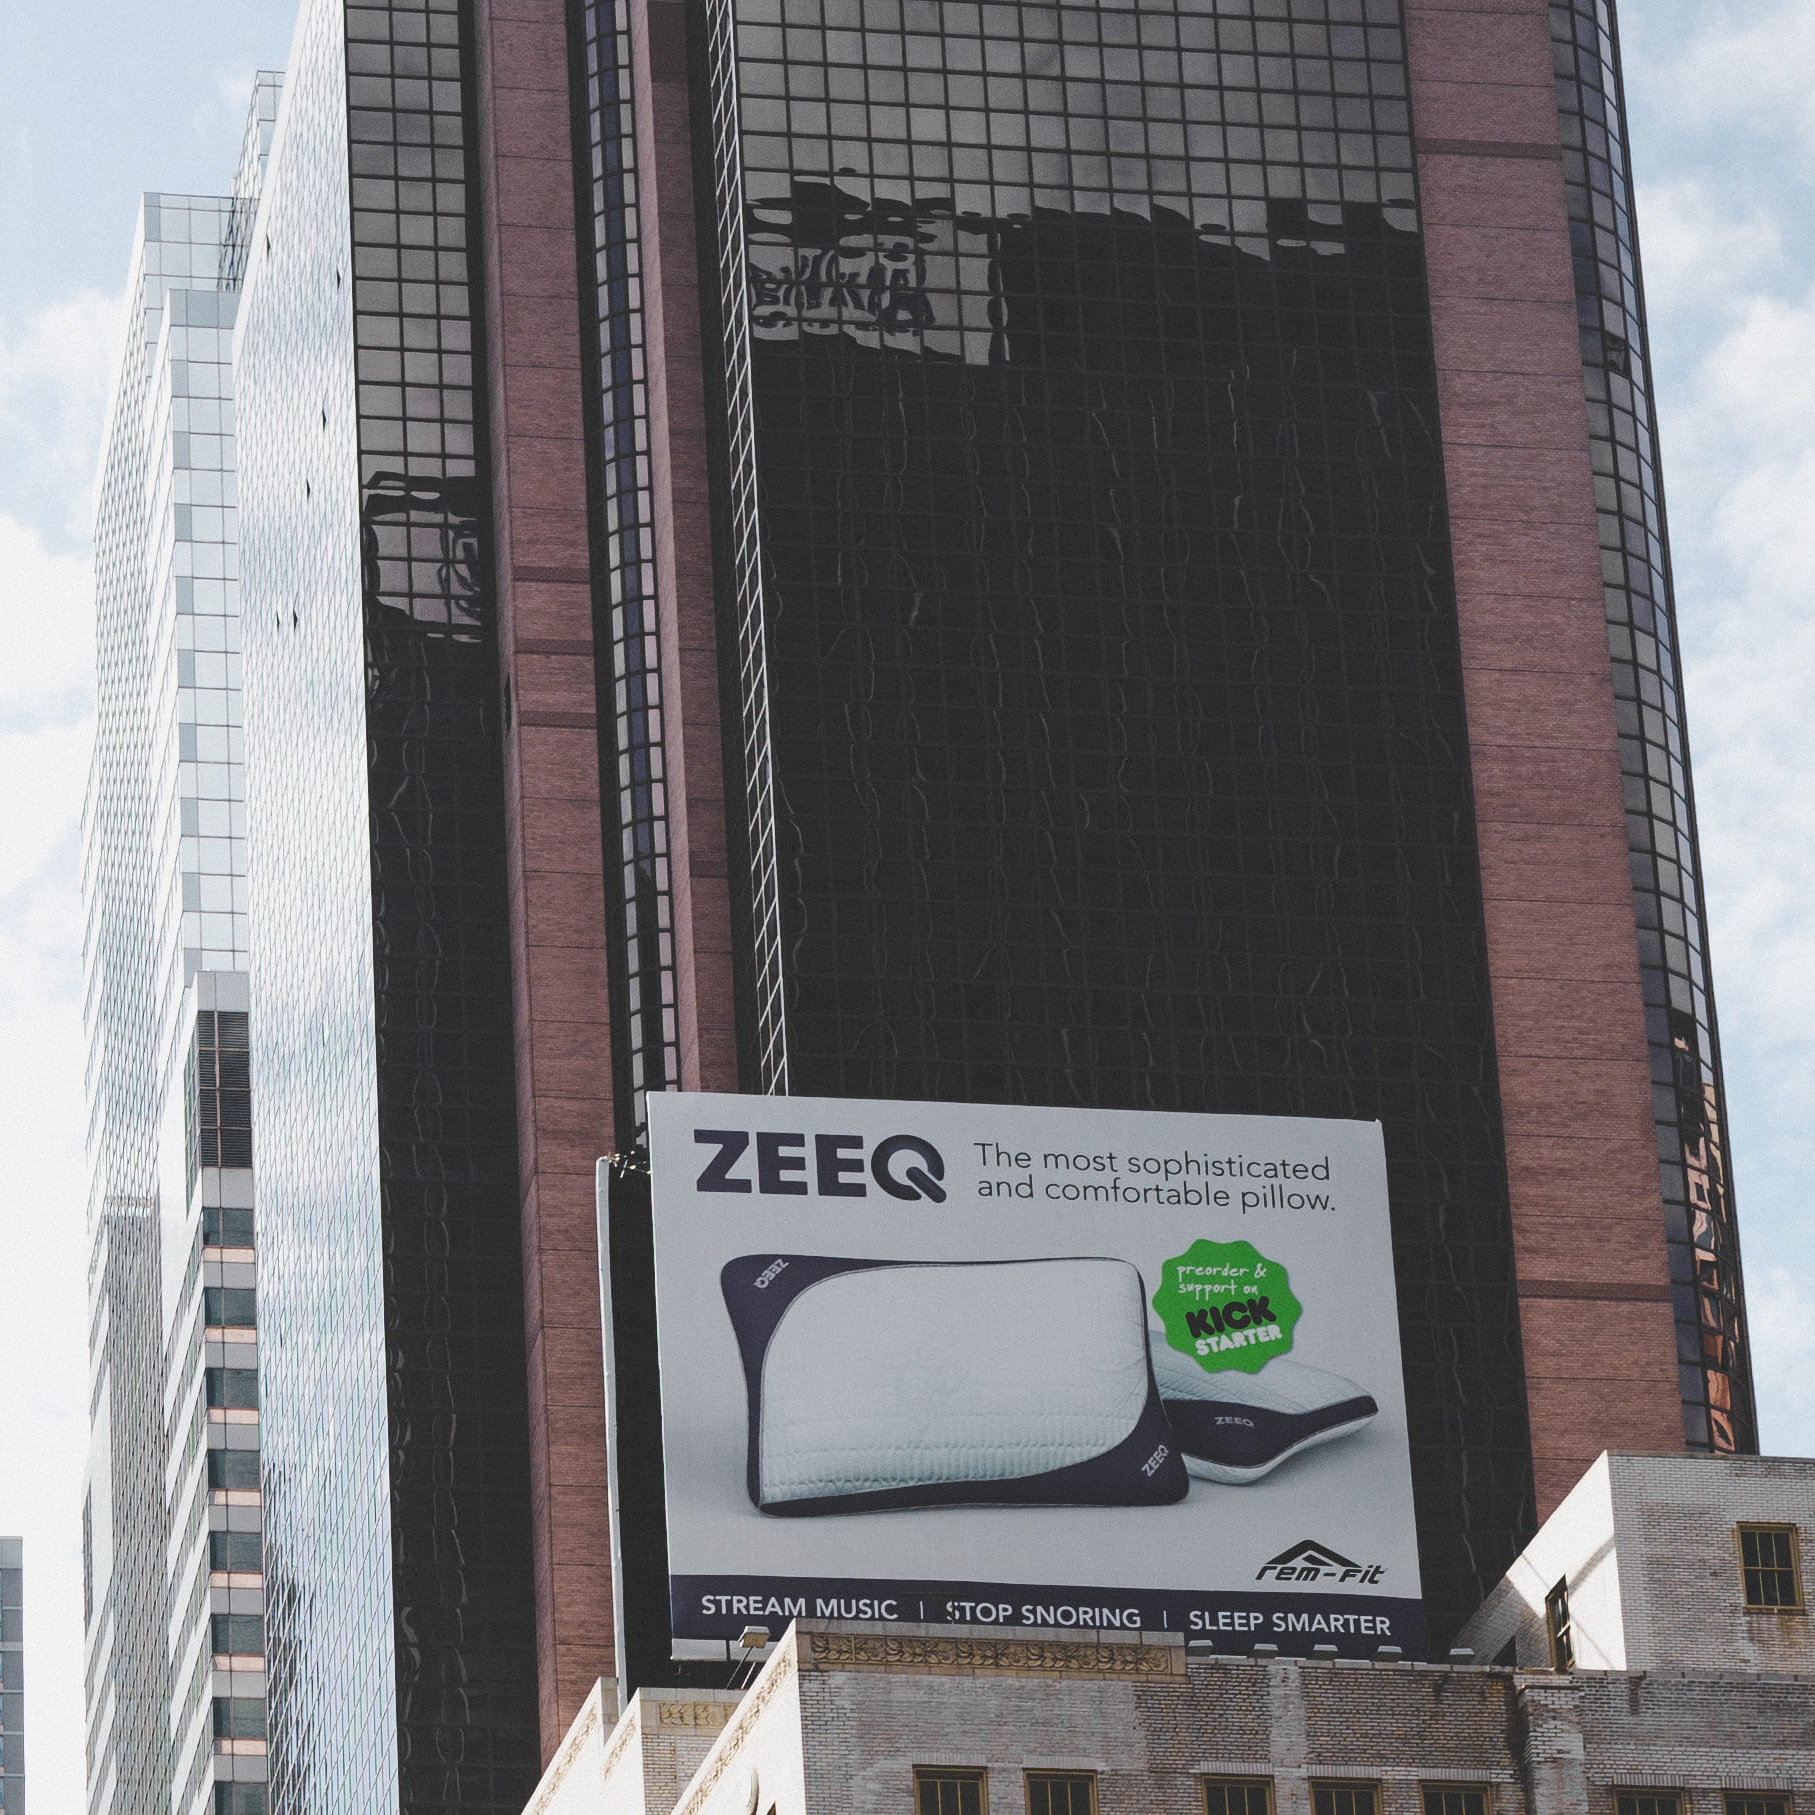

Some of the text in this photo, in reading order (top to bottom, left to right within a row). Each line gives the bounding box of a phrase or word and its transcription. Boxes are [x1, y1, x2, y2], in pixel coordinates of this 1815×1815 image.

[694, 1129, 947, 1203] ZEEQ
[974, 1143, 1330, 1181] The most sophisticated
[978, 1174, 1336, 1214] and comfortable pillow.
[754, 1258, 790, 1290] ZEEQ
[1177, 1263, 1267, 1282] preorder &
[1178, 1279, 1258, 1301] support on
[1185, 1295, 1277, 1339] KICK
[1194, 1324, 1283, 1356] STARTER
[1215, 1416, 1255, 1428] ZEEQ
[1141, 1444, 1170, 1478] ZEEQ
[701, 1594, 1392, 1637] STREAM MUSIC STOP SNORING SLEEP SMARTER
